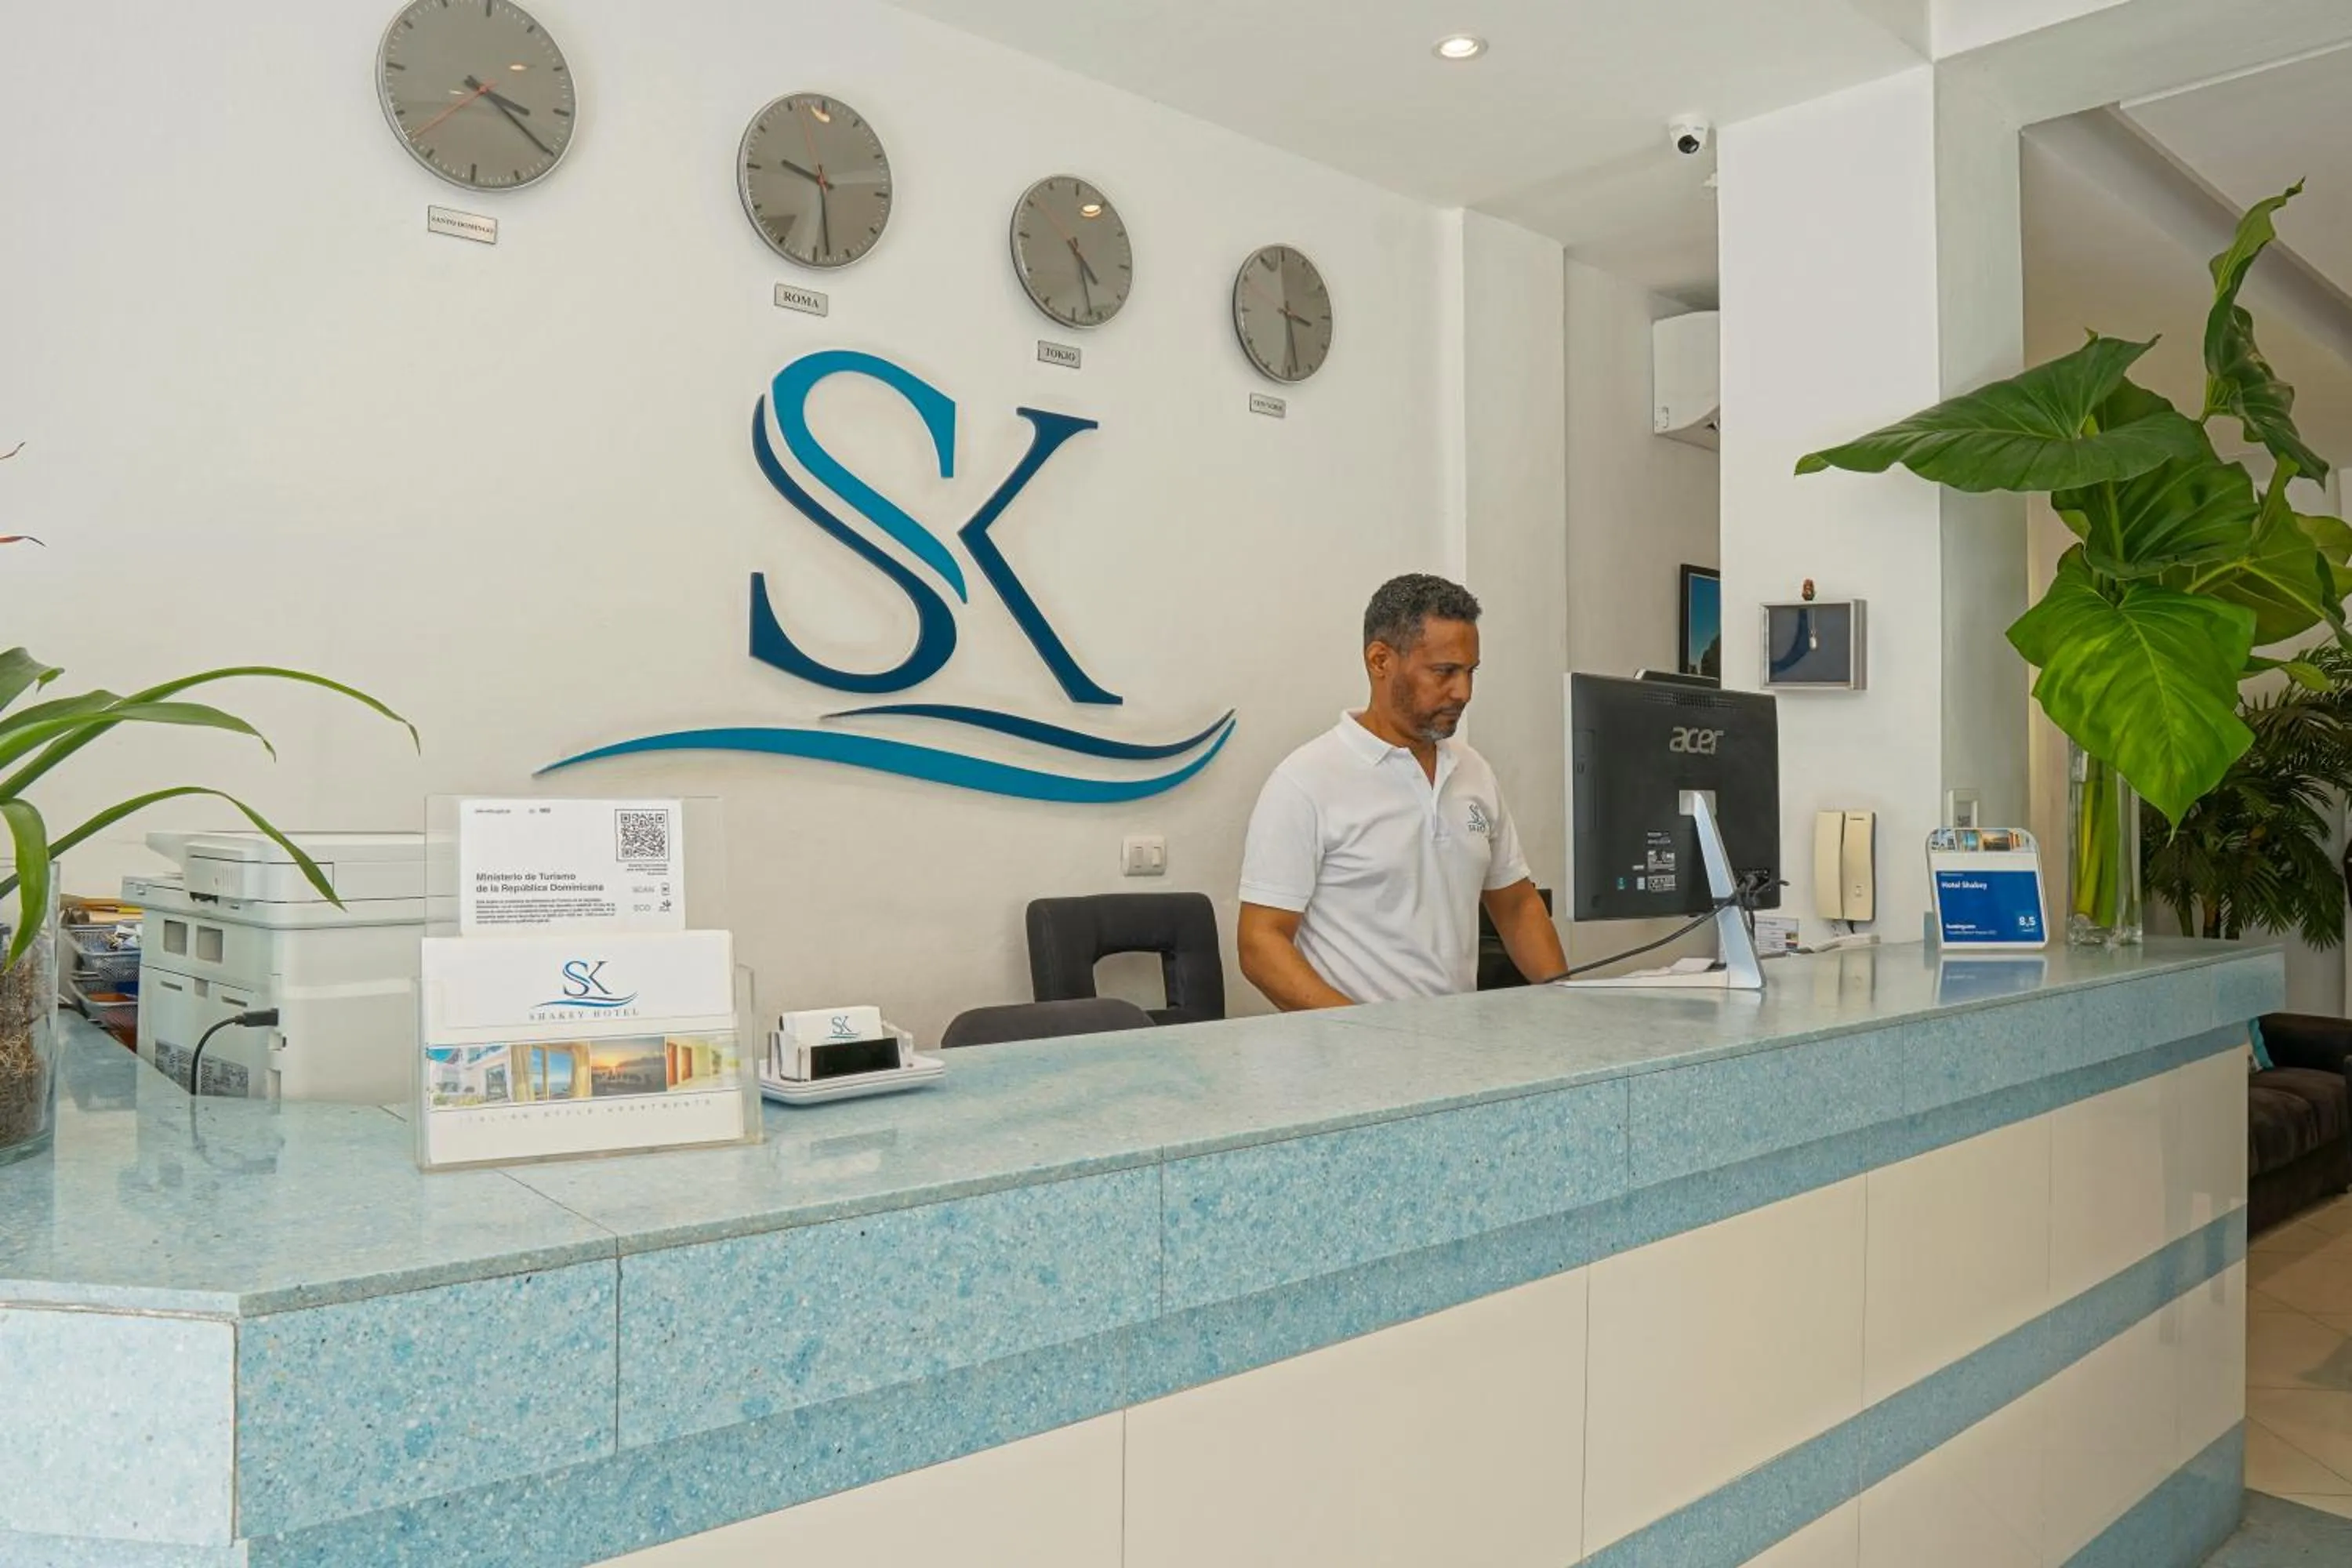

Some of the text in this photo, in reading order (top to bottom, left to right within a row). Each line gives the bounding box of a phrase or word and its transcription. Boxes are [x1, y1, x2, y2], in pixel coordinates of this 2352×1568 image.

[784, 291, 819, 308] ROMA
[749, 350, 1123, 706] SK
[1669, 727, 1724, 755] acer
[476, 872, 523, 881] Ministerio
[539, 872, 576, 880] Turismo
[476, 884, 488, 893] de
[490, 884, 499, 892] la
[550, 883, 604, 891] Dominicana
[562, 960, 613, 996] SK
[593, 1007, 640, 1018] HOTEL
